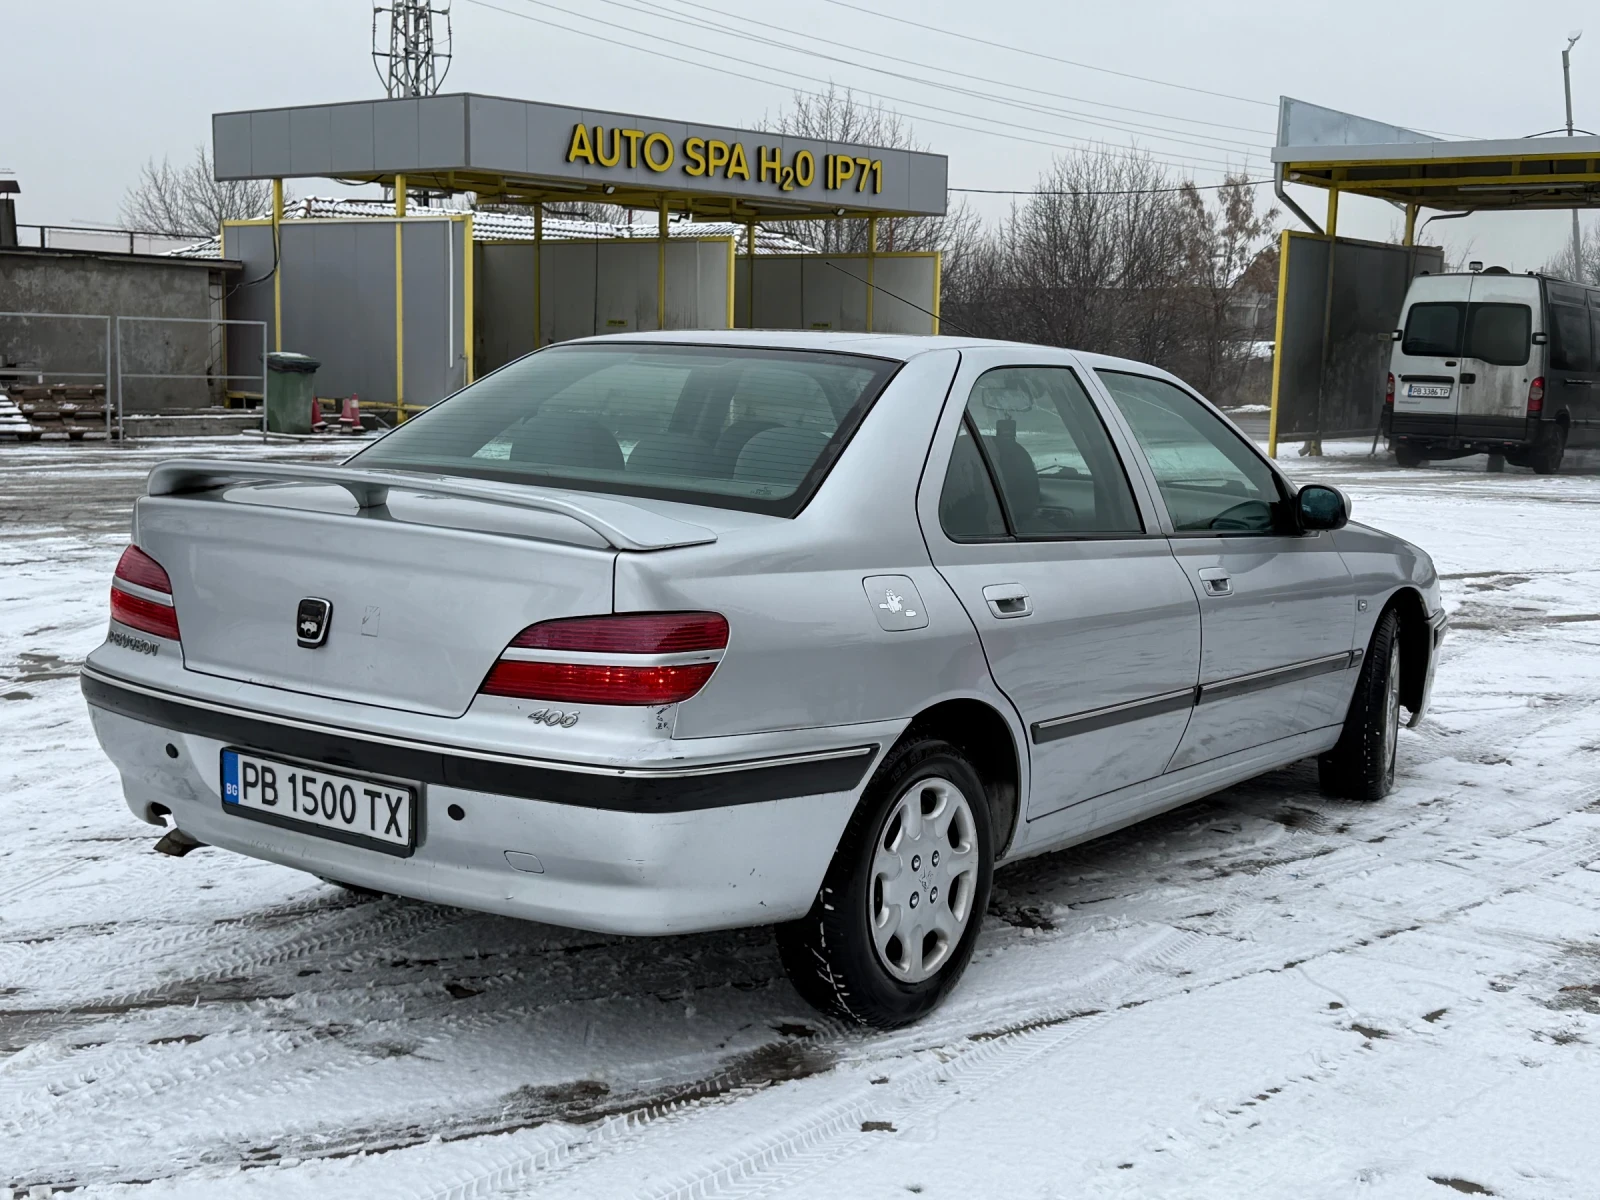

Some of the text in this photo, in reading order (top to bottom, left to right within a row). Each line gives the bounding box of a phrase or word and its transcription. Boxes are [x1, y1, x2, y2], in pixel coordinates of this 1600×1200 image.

[567, 123, 675, 173] AUTO
[684, 137, 750, 181] SPA
[826, 154, 883, 194] IP71
[1412, 387, 1422, 395] PB
[1439, 388, 1449, 396] TP
[527, 708, 581, 728] 406
[226, 782, 238, 797] BG
[242, 761, 403, 838] PB 1500 TX
